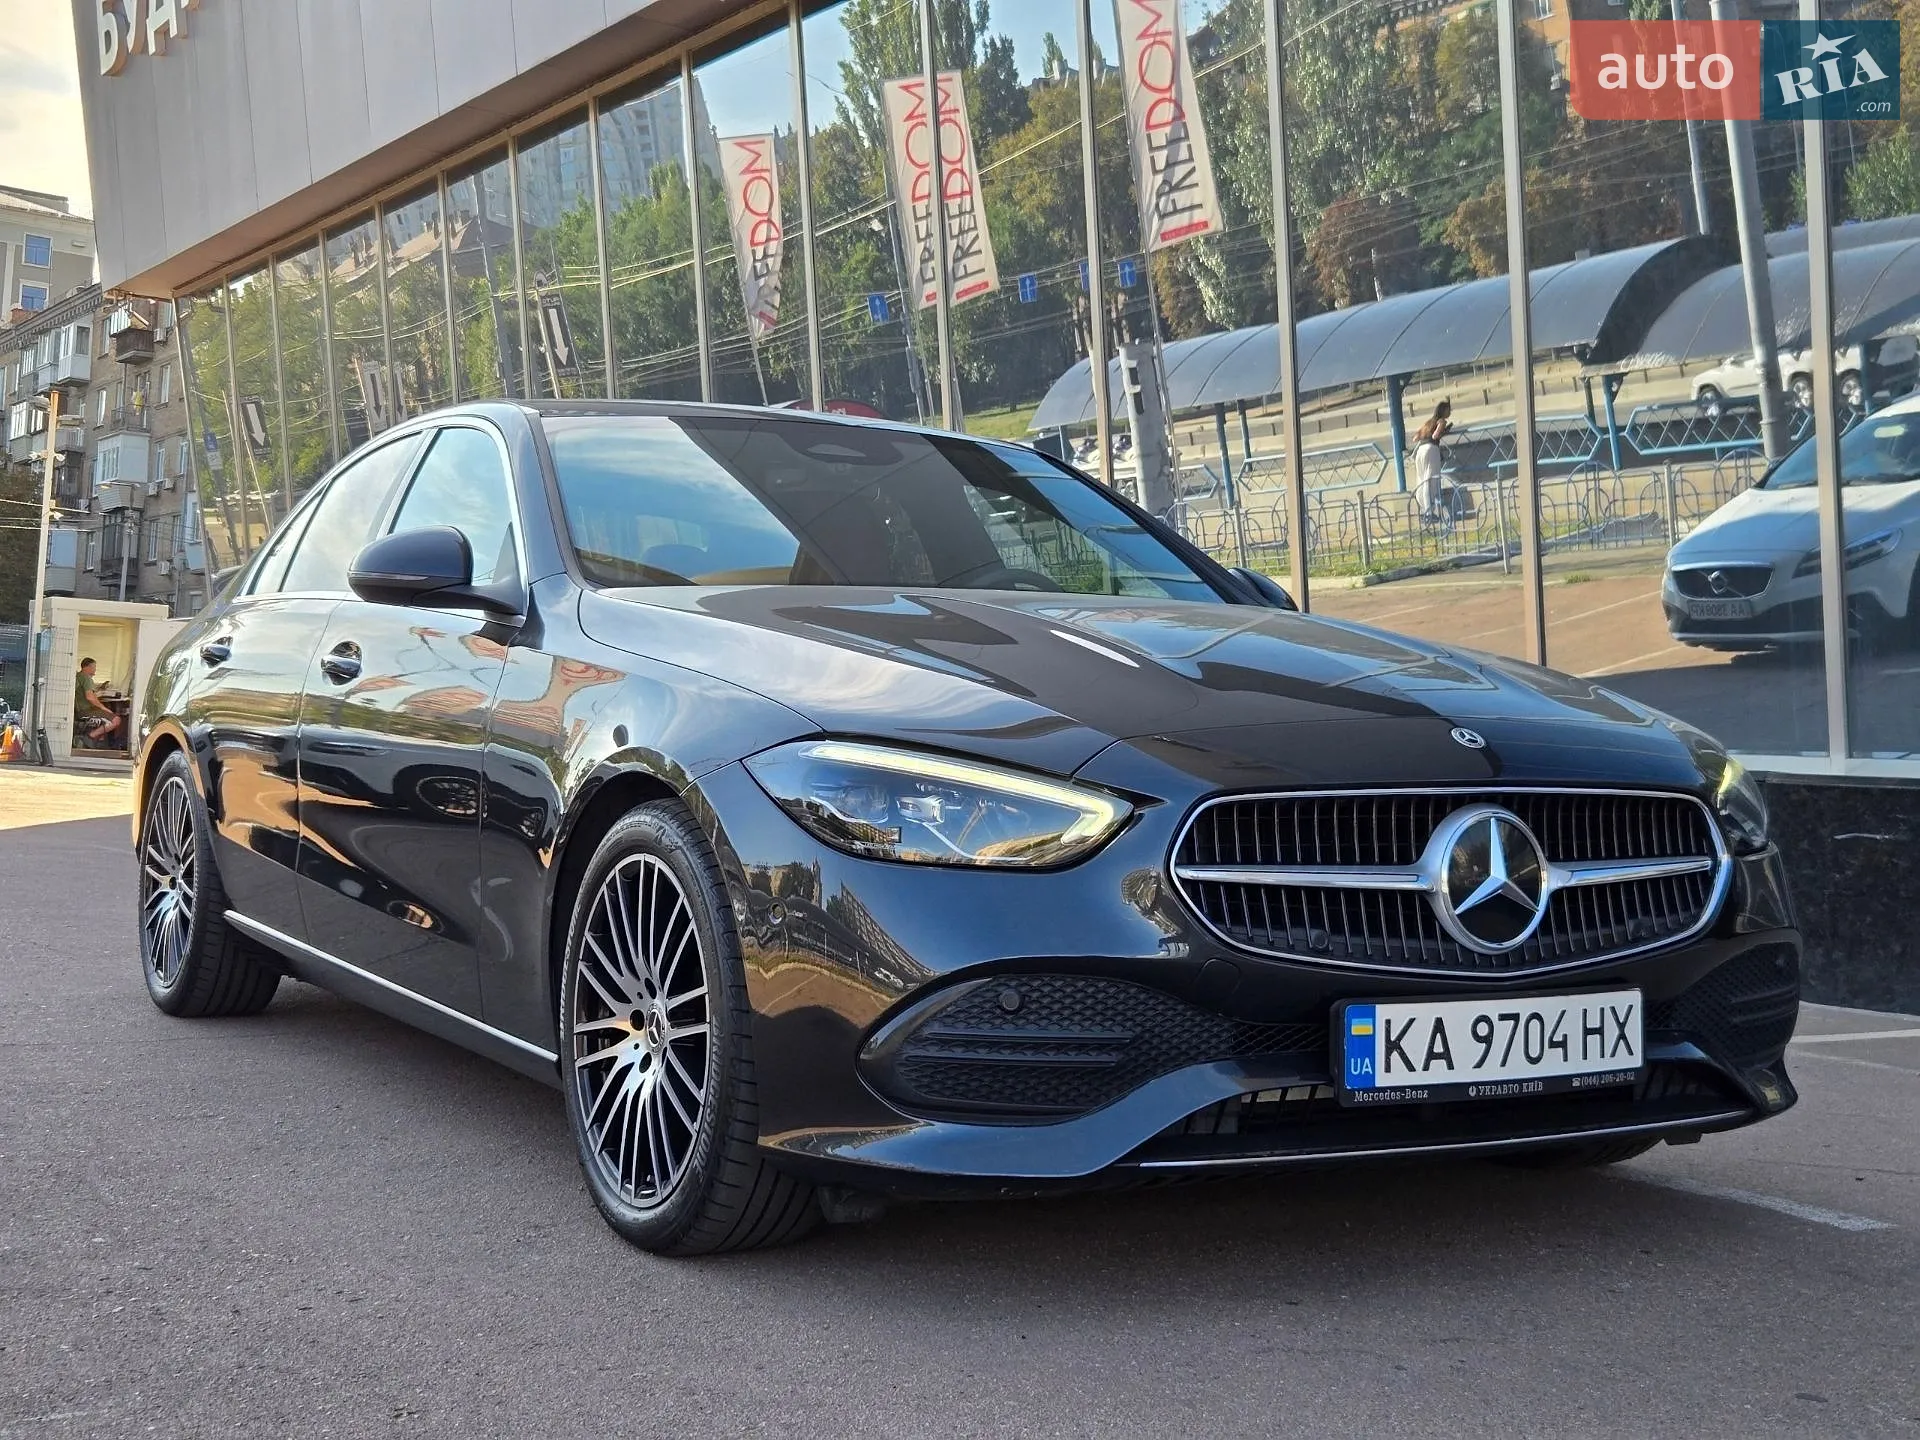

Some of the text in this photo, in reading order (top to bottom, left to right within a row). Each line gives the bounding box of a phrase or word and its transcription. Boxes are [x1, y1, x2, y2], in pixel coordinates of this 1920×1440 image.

[96, 0, 192, 76] БУД
[1383, 1003, 1635, 1073] KA 9704 HX
[1350, 1057, 1373, 1076] UA
[1354, 1088, 1429, 1102] Mercedes-Benz
[1478, 1084, 1520, 1097] УКРАВТО
